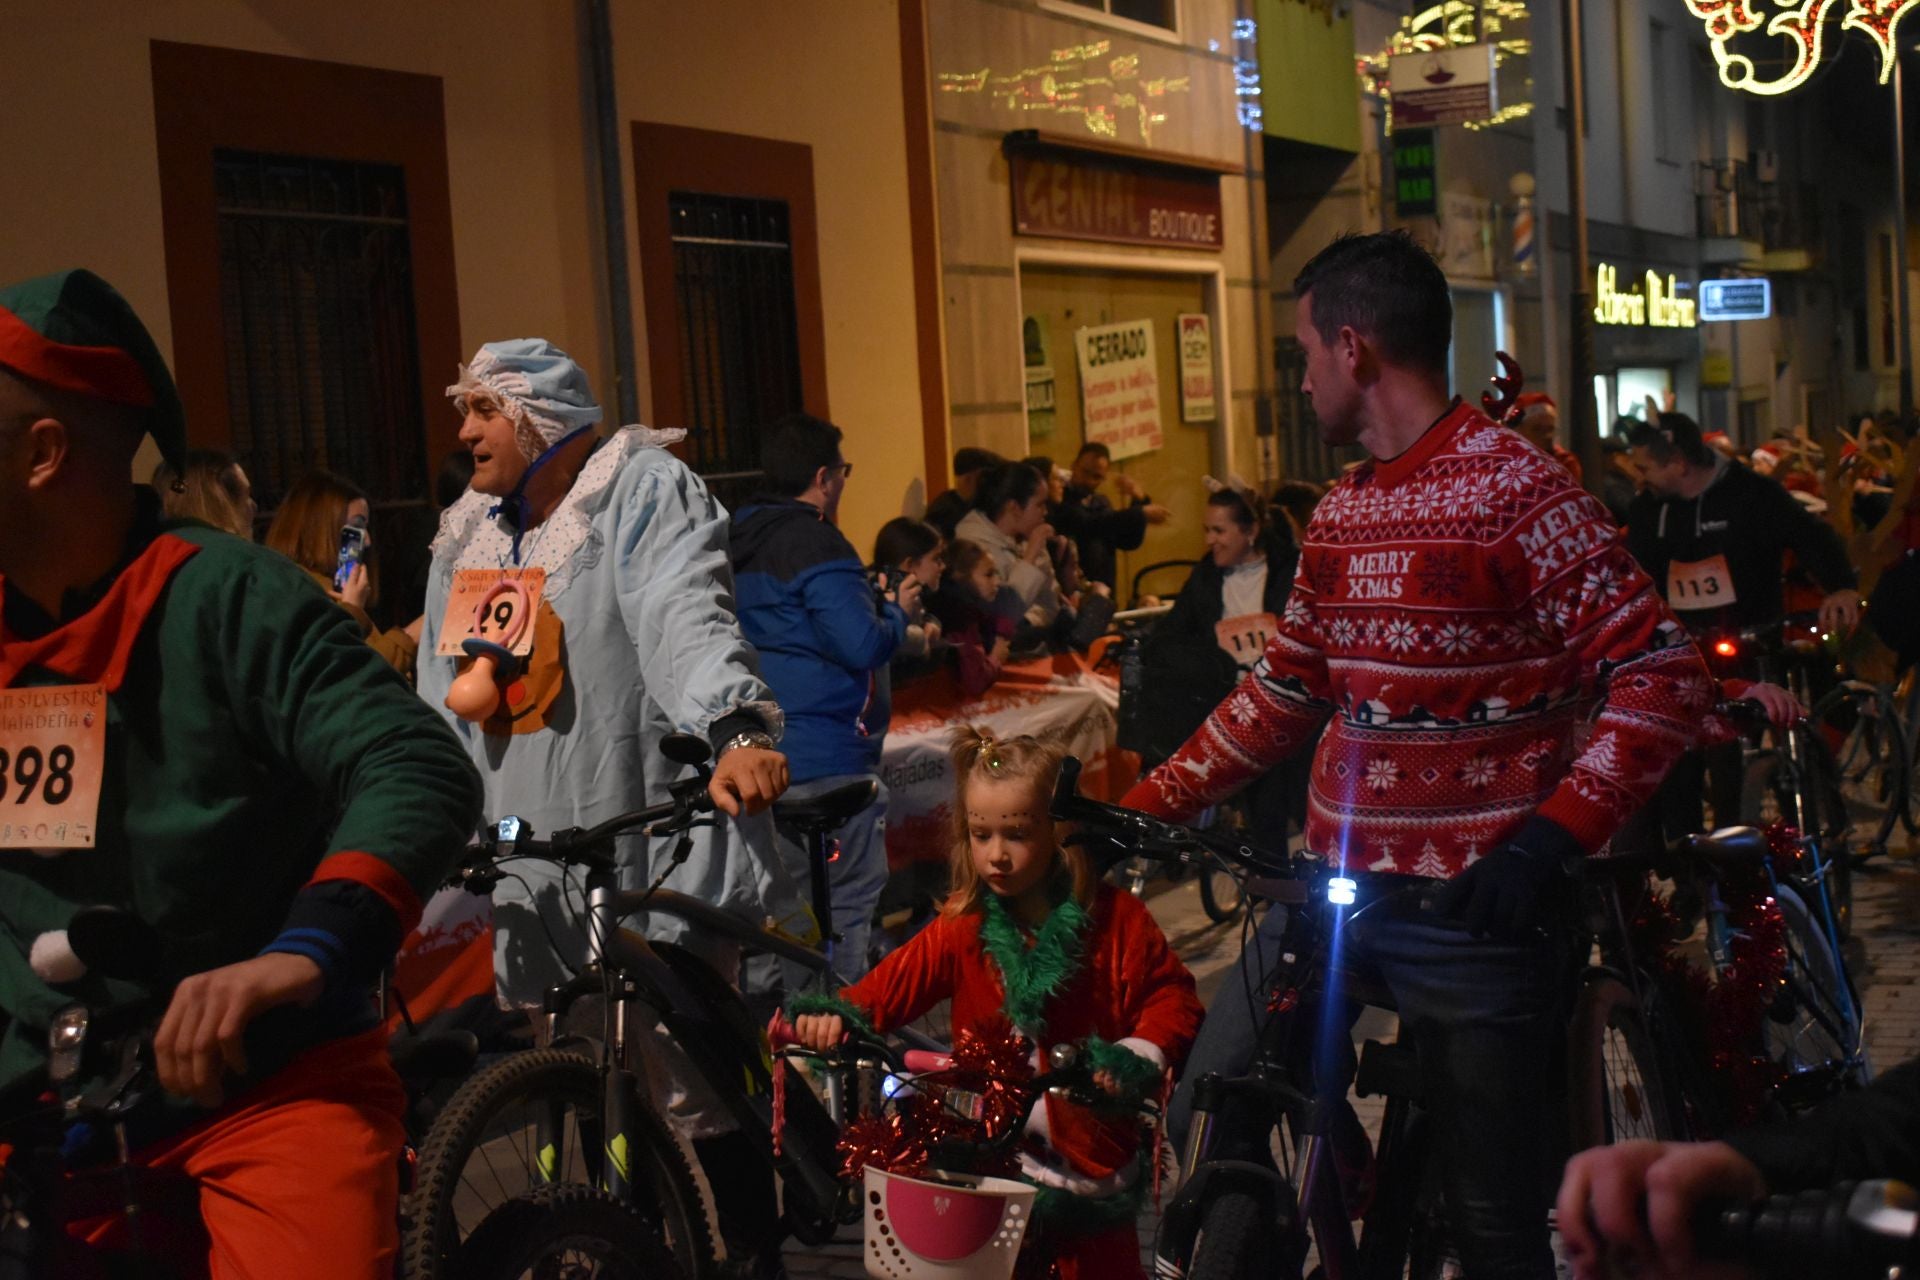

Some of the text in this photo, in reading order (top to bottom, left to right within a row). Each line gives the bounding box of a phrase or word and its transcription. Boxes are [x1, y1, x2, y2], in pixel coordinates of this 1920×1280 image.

[1149, 207, 1217, 242] BOUTIQUE
[1086, 327, 1146, 367] CERRADO
[1515, 495, 1602, 560] MERR
[1346, 550, 1416, 576] MERRY
[1531, 523, 1614, 581] XMA
[1346, 576, 1403, 599] XMAS
[1675, 576, 1719, 597] 113
[467, 601, 514, 634] 29
